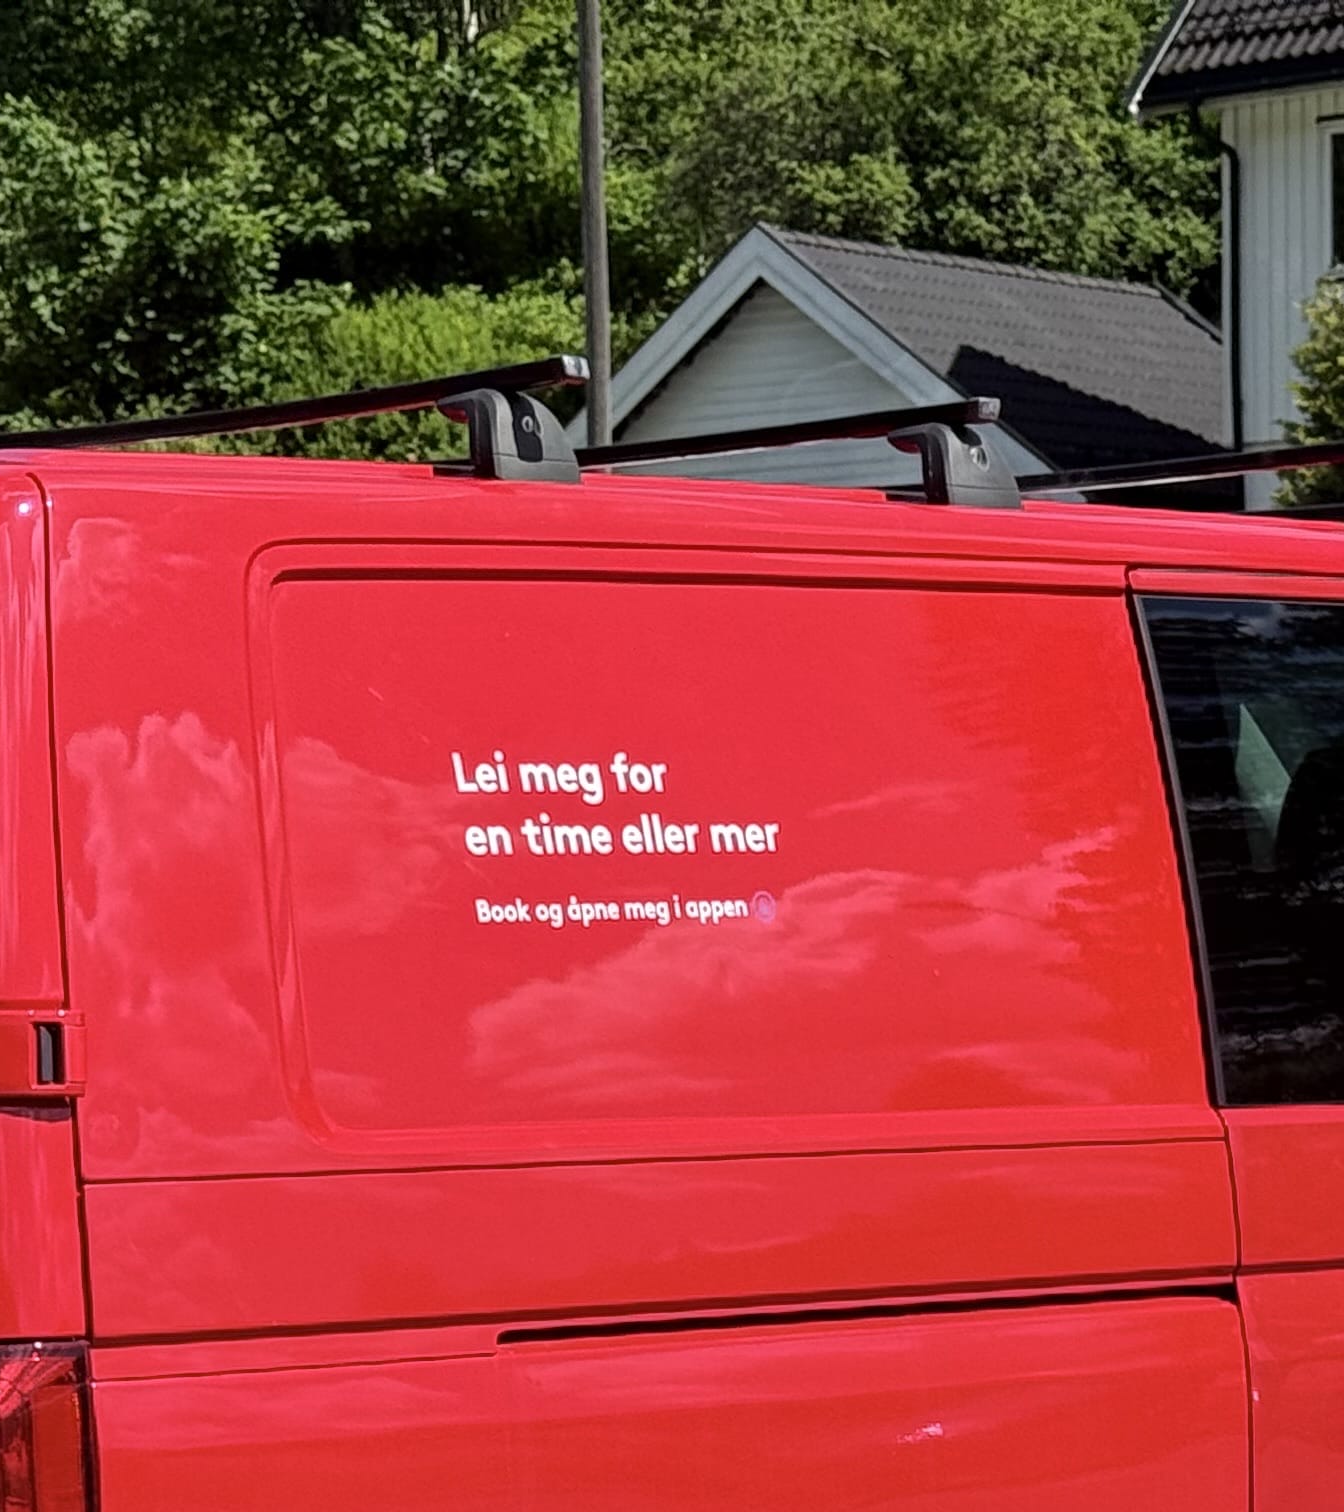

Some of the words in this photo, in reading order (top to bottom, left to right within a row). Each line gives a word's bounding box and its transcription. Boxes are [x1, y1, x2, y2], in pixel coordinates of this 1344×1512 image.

[451, 750, 509, 793] Lei
[518, 761, 605, 805] meg
[610, 752, 668, 793] for
[465, 823, 513, 856] en
[521, 812, 613, 856] time
[621, 813, 699, 854] eller
[710, 822, 779, 853] mer
[475, 897, 532, 923] Book
[535, 902, 565, 928] og
[567, 895, 620, 928] åpne
[624, 901, 670, 926] meg
[672, 894, 681, 919] i
[685, 897, 749, 925] appen
